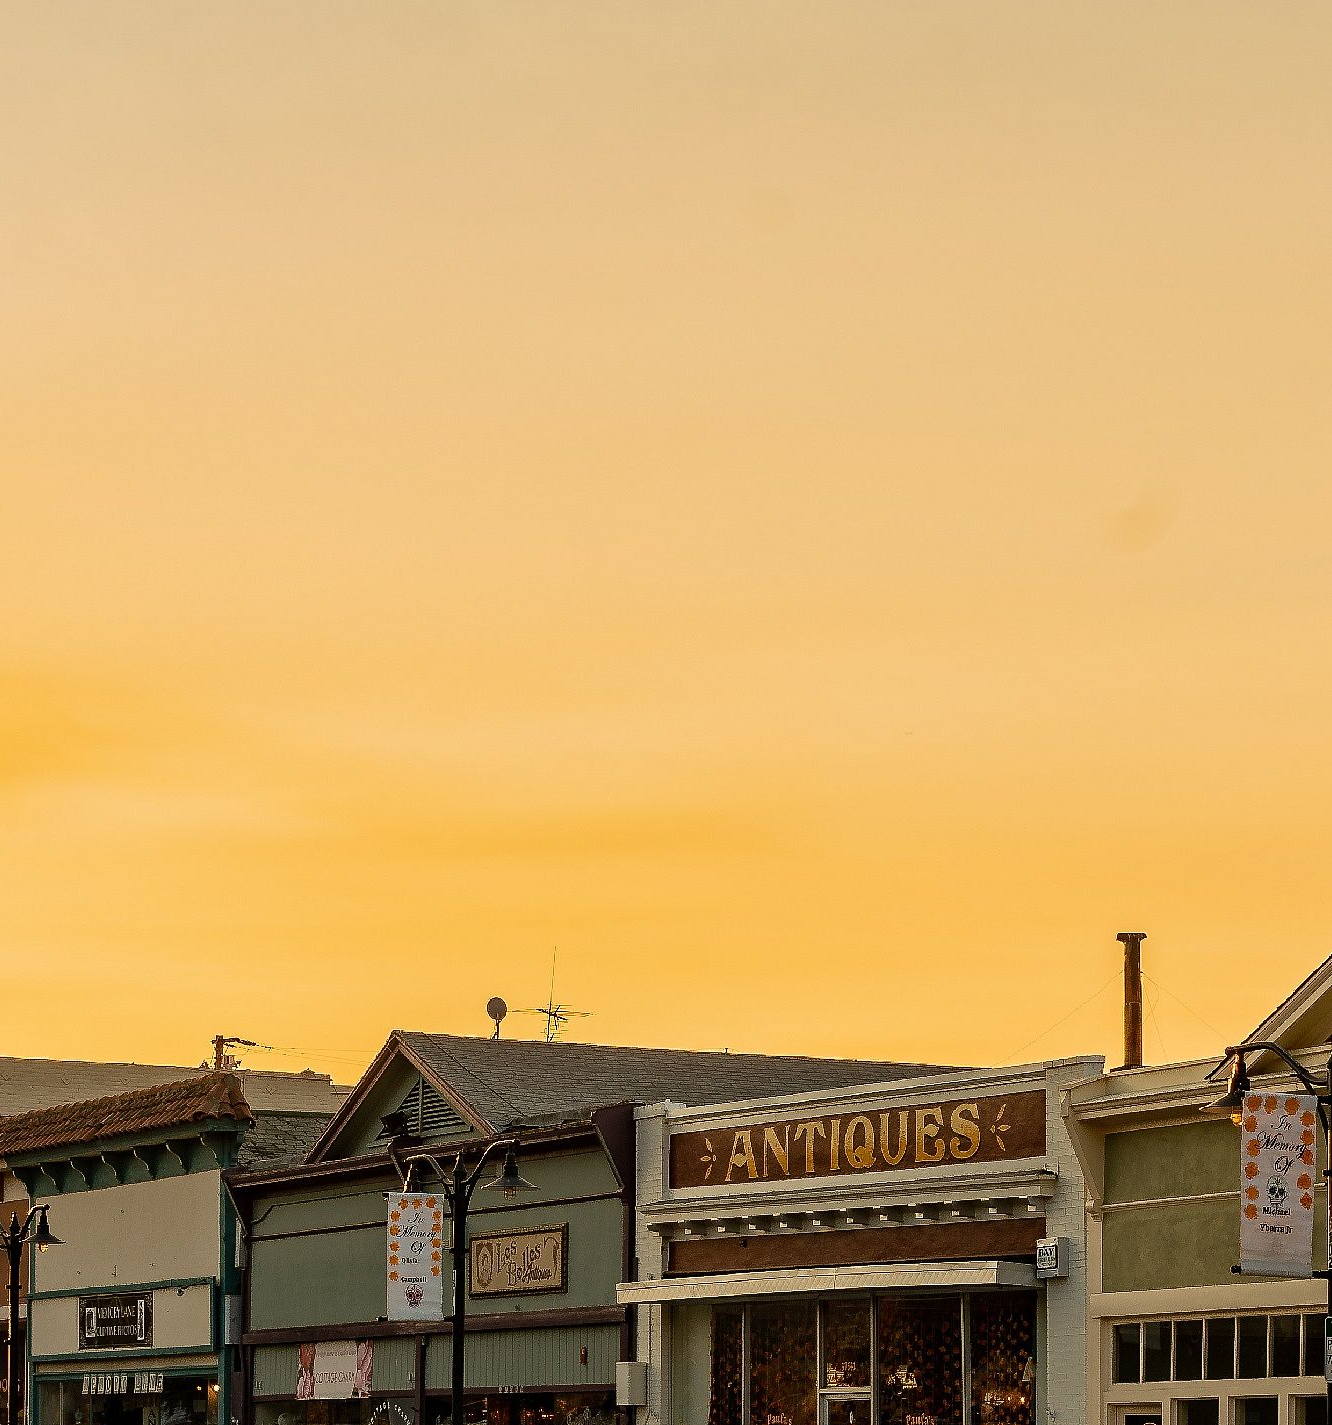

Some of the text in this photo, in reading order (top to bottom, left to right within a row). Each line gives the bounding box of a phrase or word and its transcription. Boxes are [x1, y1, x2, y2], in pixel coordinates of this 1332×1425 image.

[1270, 1114, 1293, 1131] In
[725, 1103, 981, 1182] ANTIQUES
[1254, 1133, 1309, 1158] Memory
[1274, 1155, 1296, 1175] Of
[408, 1212, 425, 1224] In
[1262, 1206, 1291, 1217] Michael
[396, 1225, 437, 1241] Memory
[410, 1240, 427, 1255] Of
[97, 1305, 135, 1319] MEMORY LANE
